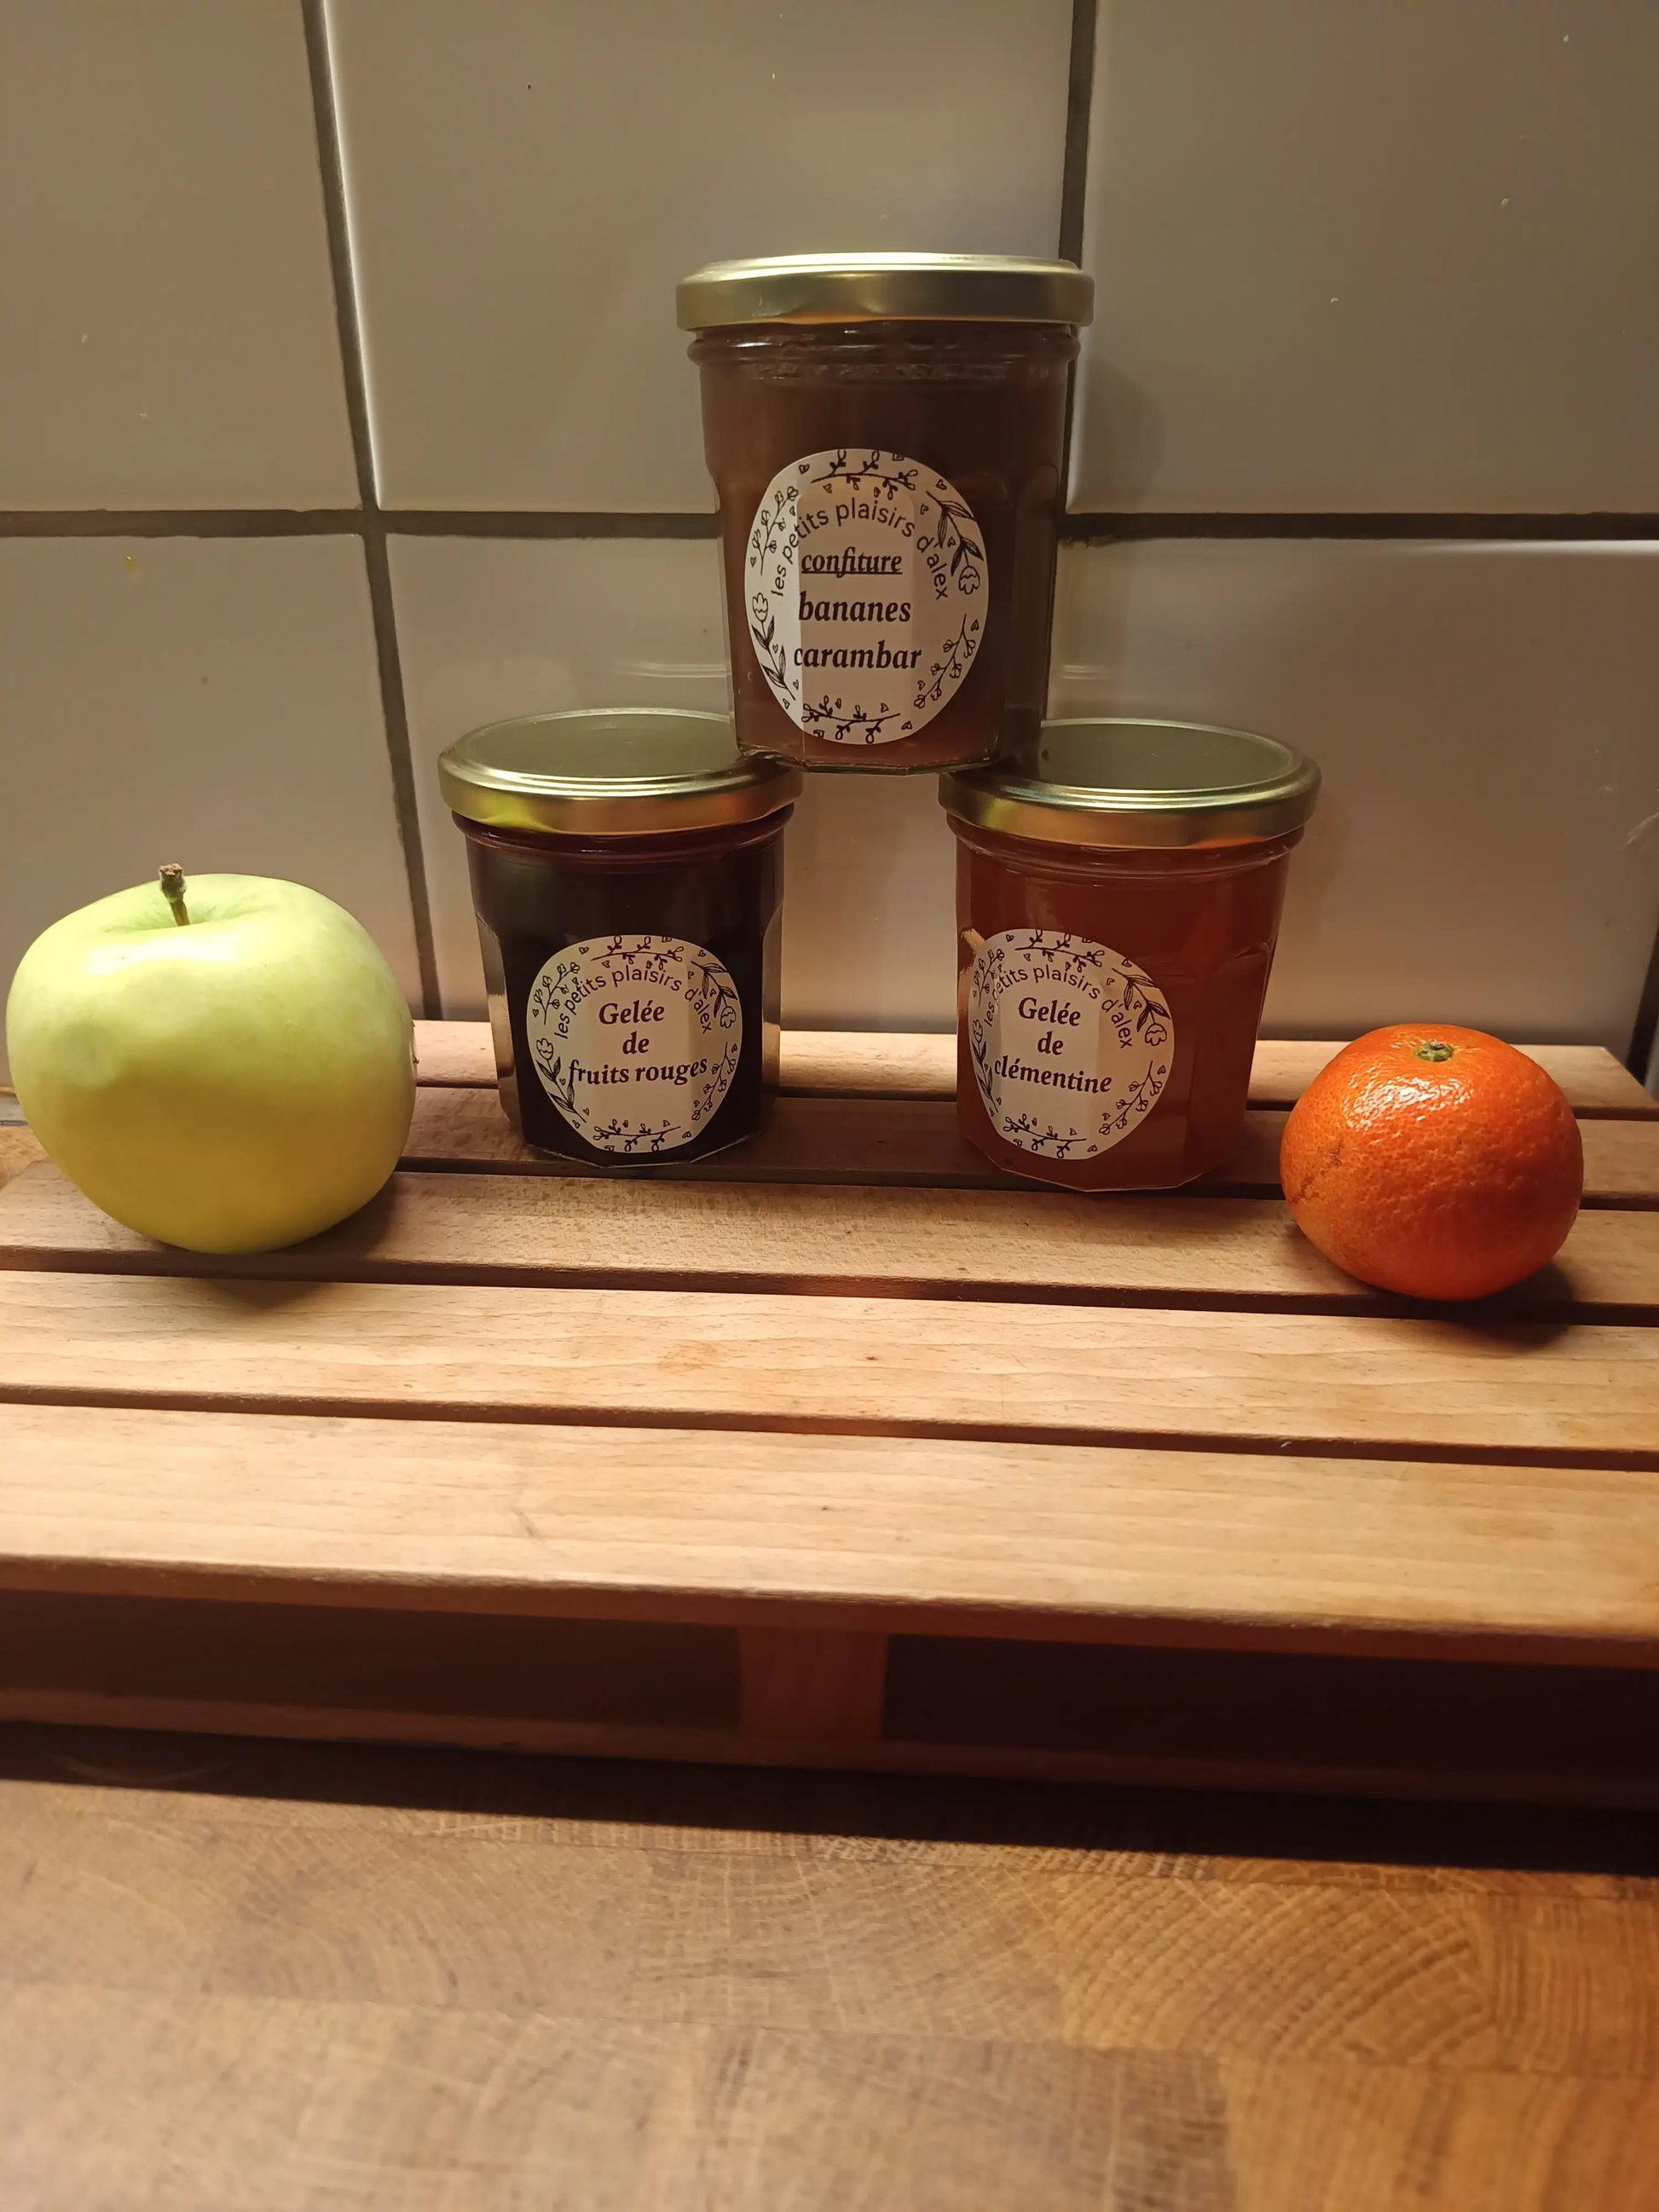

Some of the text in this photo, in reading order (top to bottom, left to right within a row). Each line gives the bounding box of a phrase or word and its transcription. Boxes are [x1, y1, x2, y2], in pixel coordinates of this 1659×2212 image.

[771, 563, 787, 597] les
[782, 511, 830, 564] petits
[835, 497, 916, 538] plaisirs
[801, 546, 903, 579] confiture
[798, 591, 911, 622] bananes
[794, 640, 922, 668] carambar
[554, 1013, 570, 1039] les
[564, 975, 606, 1015] petits
[611, 964, 682, 991] plaisirs
[983, 1003, 994, 1027] les
[1033, 964, 1101, 999] plaisirs
[599, 1000, 665, 1025] Gelée
[1018, 997, 1081, 1026] Gelée
[622, 1031, 650, 1054] de
[1038, 1031, 1064, 1055] de
[569, 1058, 708, 1085] fruits rouges
[994, 1055, 1113, 1094] clémentine
